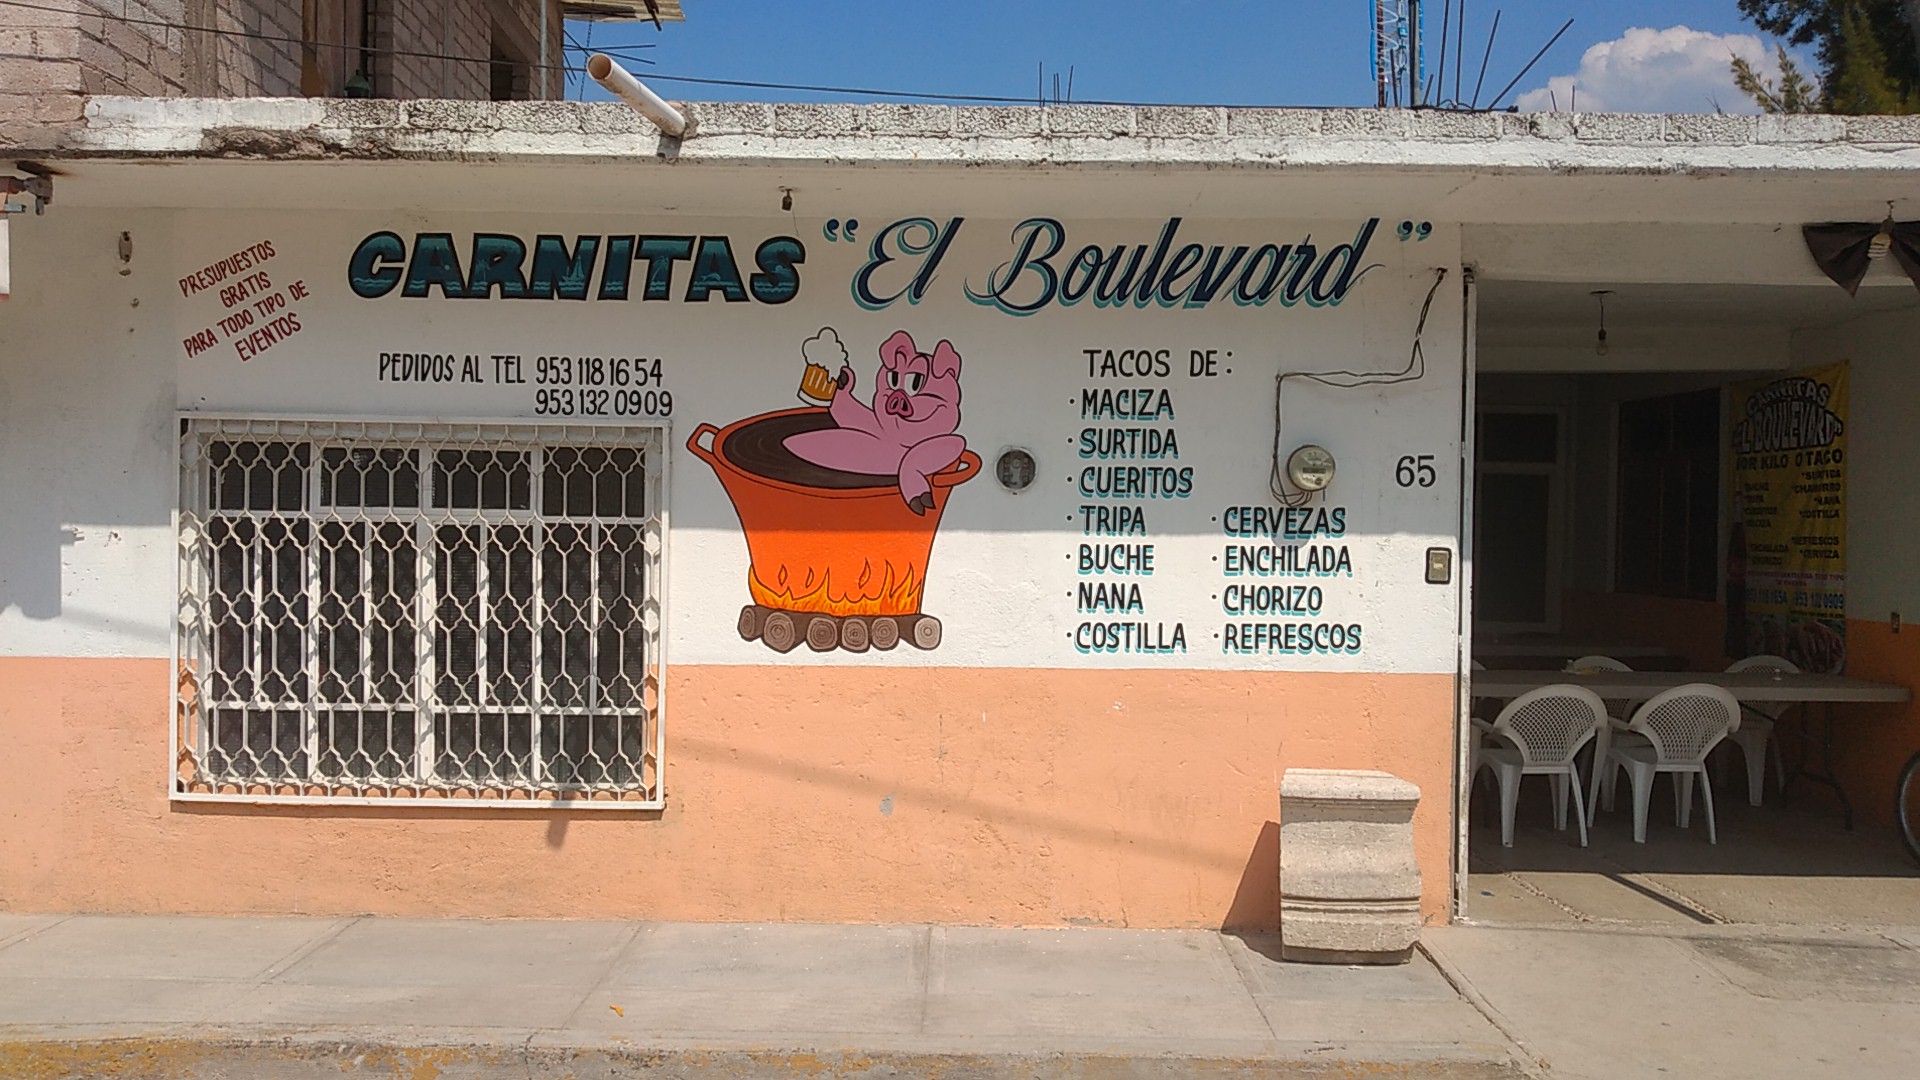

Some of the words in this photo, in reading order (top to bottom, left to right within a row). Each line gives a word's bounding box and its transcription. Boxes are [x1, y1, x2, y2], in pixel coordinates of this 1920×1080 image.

[178, 240, 276, 297] PRESUPUESTOS
[348, 231, 806, 304] CARNITAS
[219, 271, 272, 308] GRATIS
[183, 328, 219, 358] PARA
[216, 309, 254, 337] TODO
[253, 292, 286, 318] TIPO
[288, 280, 310, 301] DE
[234, 312, 301, 361] EVENTOS
[379, 352, 454, 383] PEDIDOS
[461, 355, 484, 383] AL
[491, 356, 526, 384] TEL
[536, 356, 572, 385] 953
[1083, 349, 1170, 378] TACOS
[535, 388, 574, 416] 953
[579, 389, 610, 416] 132
[614, 390, 673, 417] 0909
[1081, 389, 1174, 420] MACIZA
[1078, 428, 1178, 458] SURTIDA
[1760, 454, 1788, 469] KILO
[1806, 448, 1843, 466] TACO
[1078, 467, 1194, 498] CUERITOS
[1396, 455, 1436, 487] 65
[1079, 506, 1146, 536] TRIPA
[1223, 507, 1347, 537] CERVEZAS
[1078, 544, 1155, 575] BUCHE
[1223, 545, 1353, 576] ENCHILADA
[1077, 582, 1144, 613] NANA
[1223, 585, 1323, 616] CHORIZO
[1074, 622, 1187, 653] COSTILLA
[1222, 624, 1362, 654] REFRESCOS
